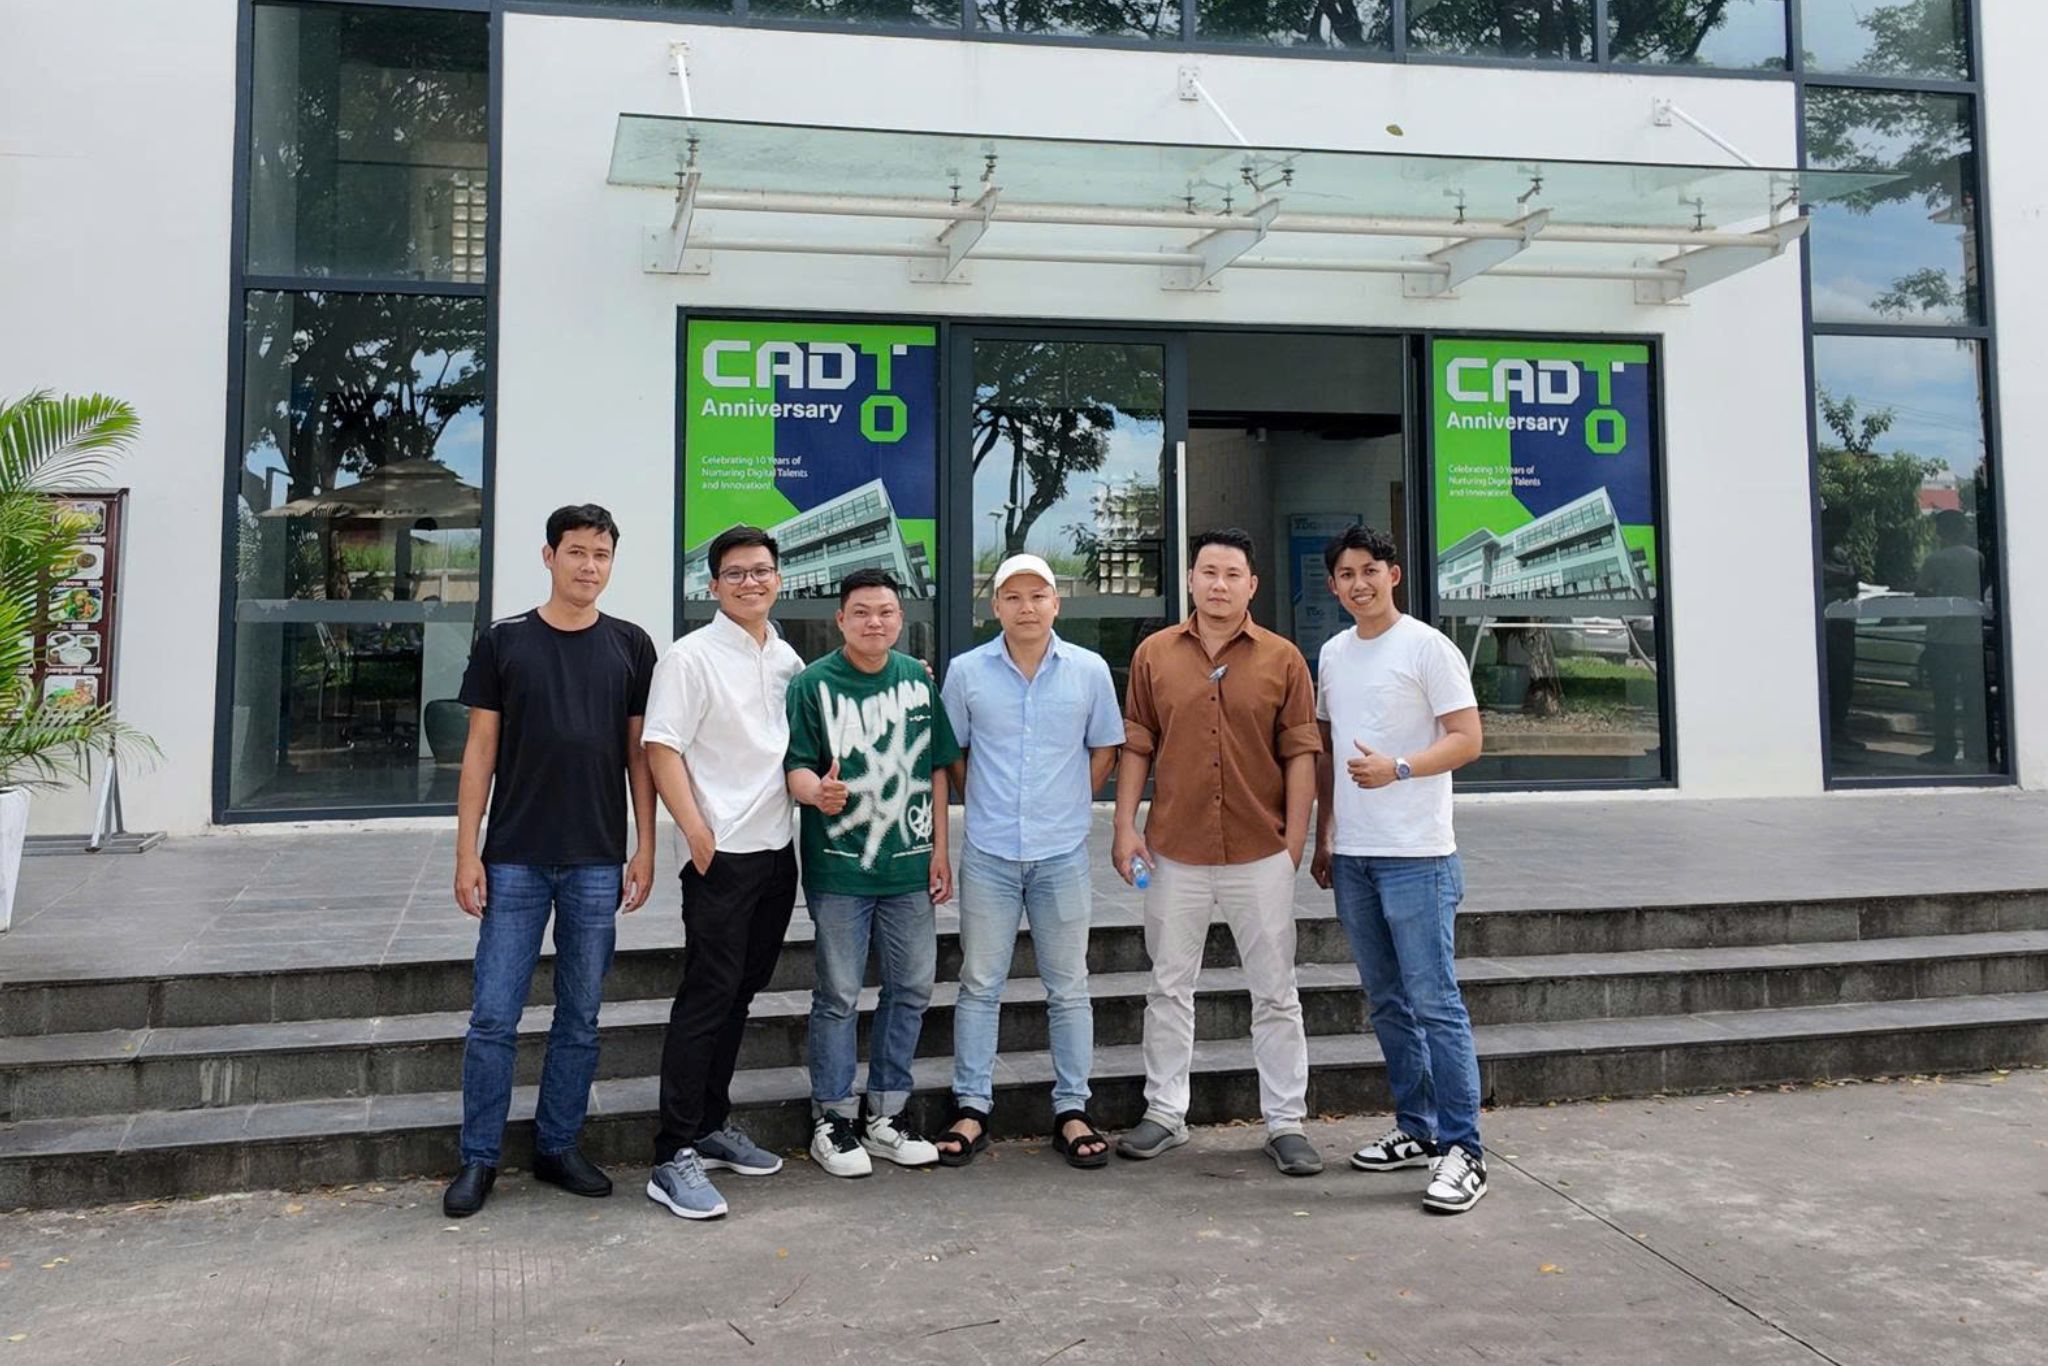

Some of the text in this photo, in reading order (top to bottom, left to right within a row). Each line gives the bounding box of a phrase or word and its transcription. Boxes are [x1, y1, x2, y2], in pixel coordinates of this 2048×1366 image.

[702, 340, 908, 391] CADT
[1446, 357, 1625, 405] CADT
[701, 398, 843, 424] Anniversary
[1446, 411, 1569, 436] Anniversary
[702, 455, 802, 466] Celebrating 10 Years of
[702, 467, 809, 480] Nurturing Digital Talents
[1448, 465, 1493, 475] Celebrating
[1506, 465, 1525, 475] Years
[1526, 465, 1535, 474] of
[702, 480, 719, 489] and
[1448, 476, 1487, 488] Nurturing
[1513, 477, 1541, 487] Talents
